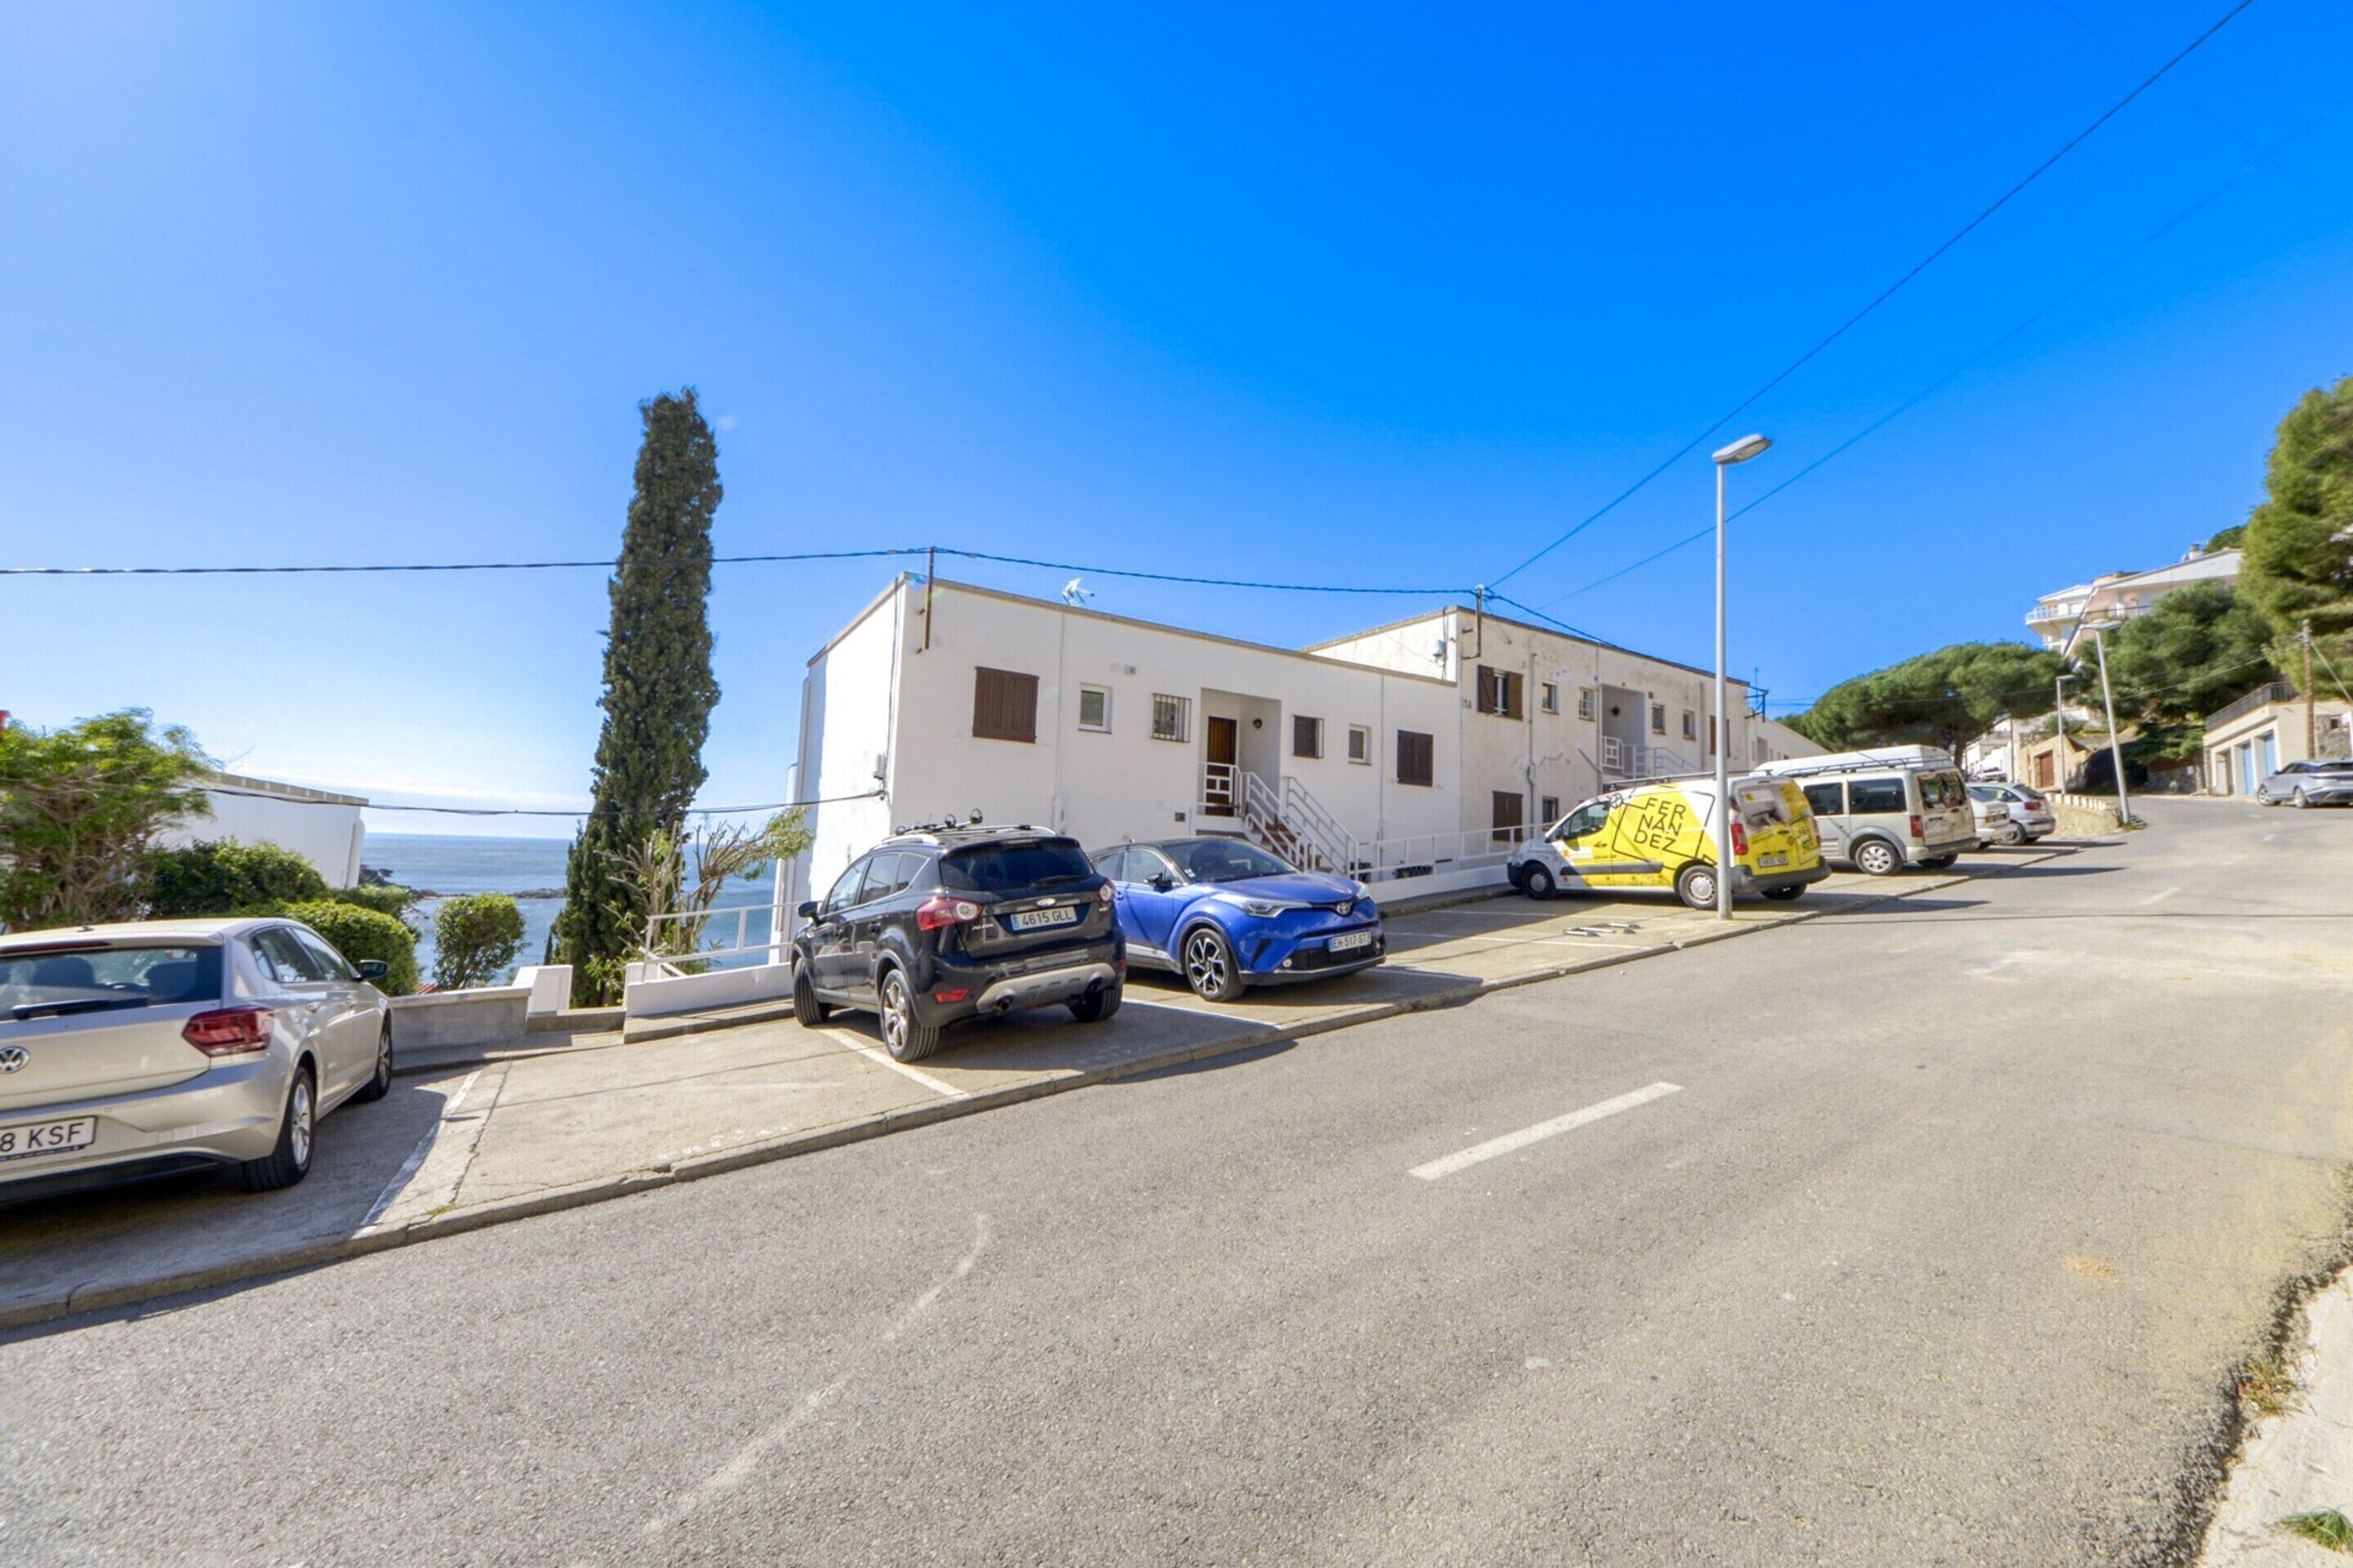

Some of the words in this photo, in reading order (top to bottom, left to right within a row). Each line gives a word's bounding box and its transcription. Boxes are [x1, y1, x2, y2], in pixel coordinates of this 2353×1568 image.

[1644, 797, 1686, 821] FER
[1634, 829, 1677, 851] DEZ
[1022, 911, 1050, 925] 4615
[1052, 909, 1073, 922] GLL
[27, 1123, 85, 1149] KSF
